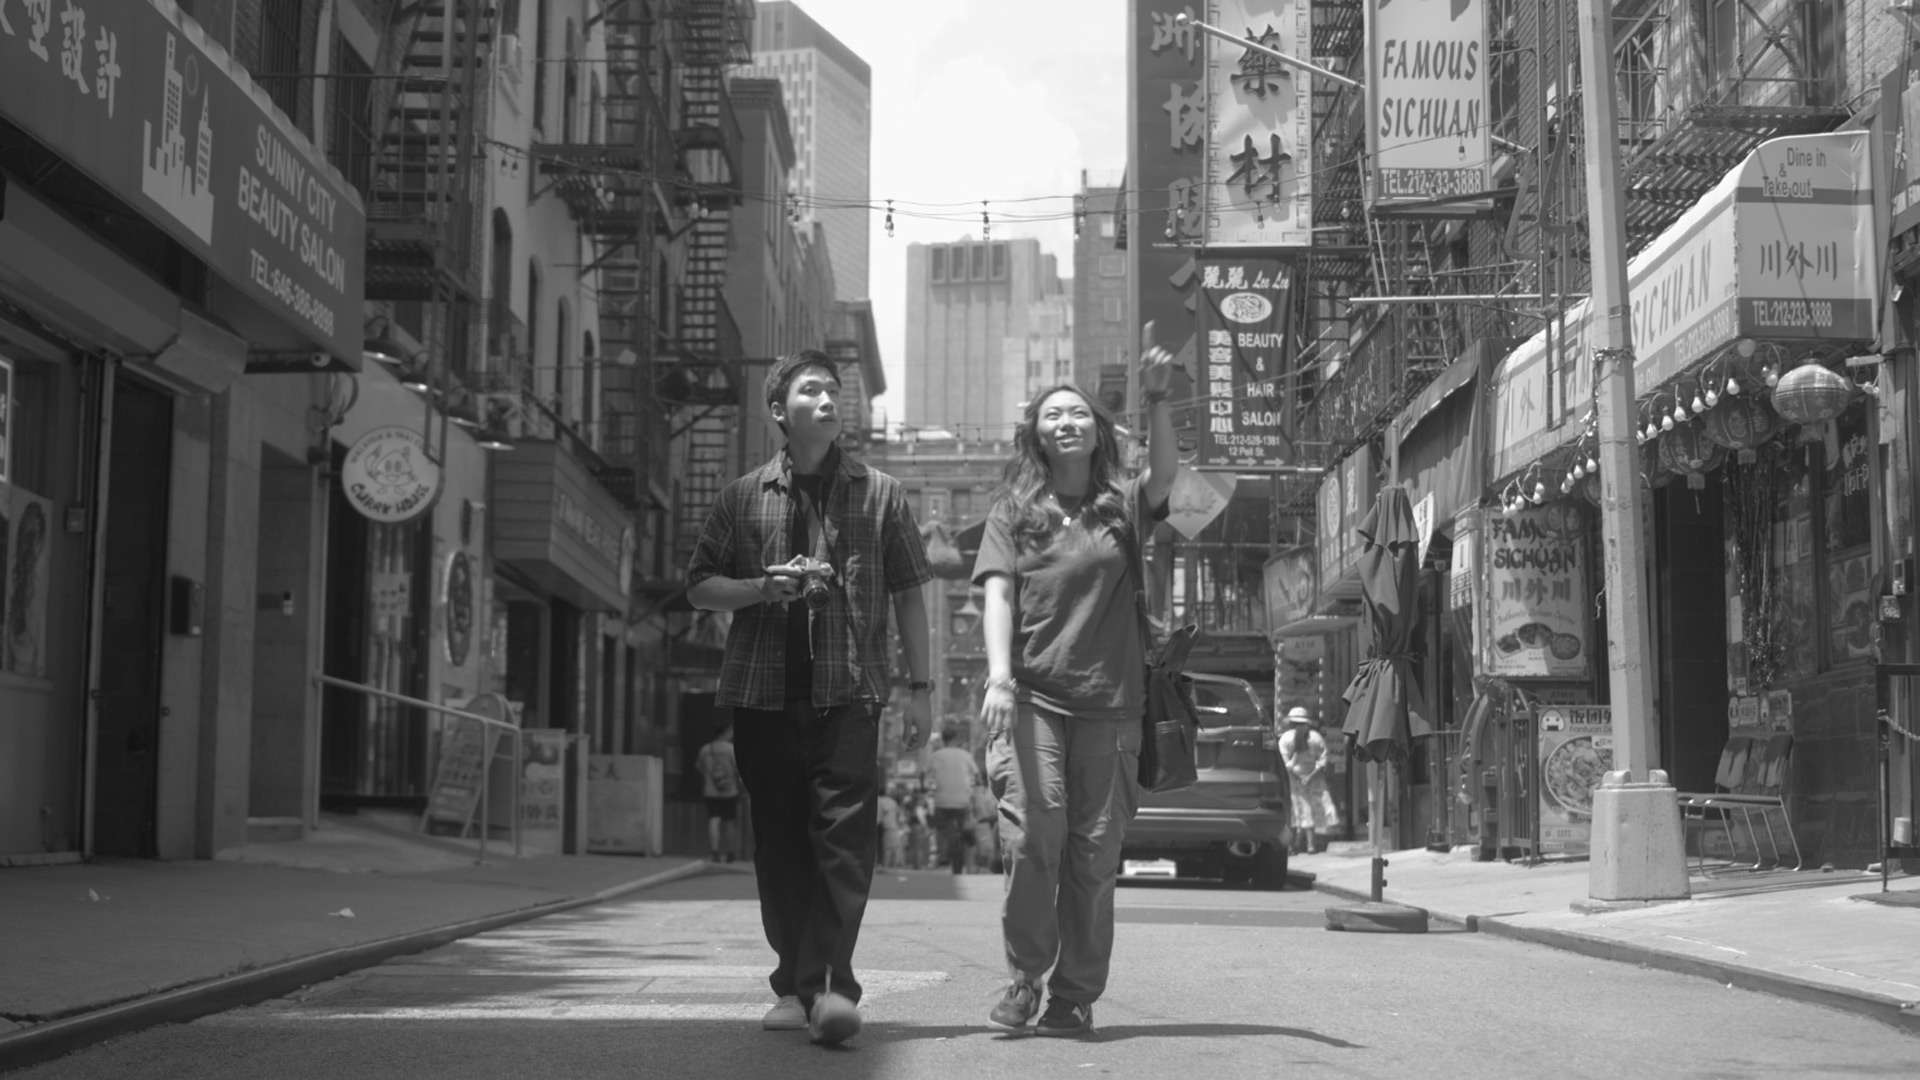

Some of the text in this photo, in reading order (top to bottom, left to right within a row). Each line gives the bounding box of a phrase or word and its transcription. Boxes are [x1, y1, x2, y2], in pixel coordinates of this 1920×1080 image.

[1382, 39, 1479, 81] FAMOUS
[1380, 97, 1480, 139] SICHUAN
[1779, 162, 1787, 178] &
[1787, 147, 1827, 168] Dine in
[256, 124, 336, 233] SUNNY CITY
[1763, 176, 1812, 198] Take out
[238, 165, 345, 294] BEAUTY SALON
[1760, 239, 1838, 281] 川外川
[1632, 238, 1711, 349] SICHUAN
[1238, 333, 1284, 348] BEAUTY
[1255, 356, 1264, 372] &
[1247, 382, 1274, 398] HAIR
[1241, 411, 1280, 427] SALON
[1228, 446, 1238, 457] 12
[350, 483, 431, 516] CURRY HOUSE
[1493, 548, 1576, 578] SICHUAN
[1502, 577, 1572, 607] 川外川
[1294, 640, 1316, 650] ATM
